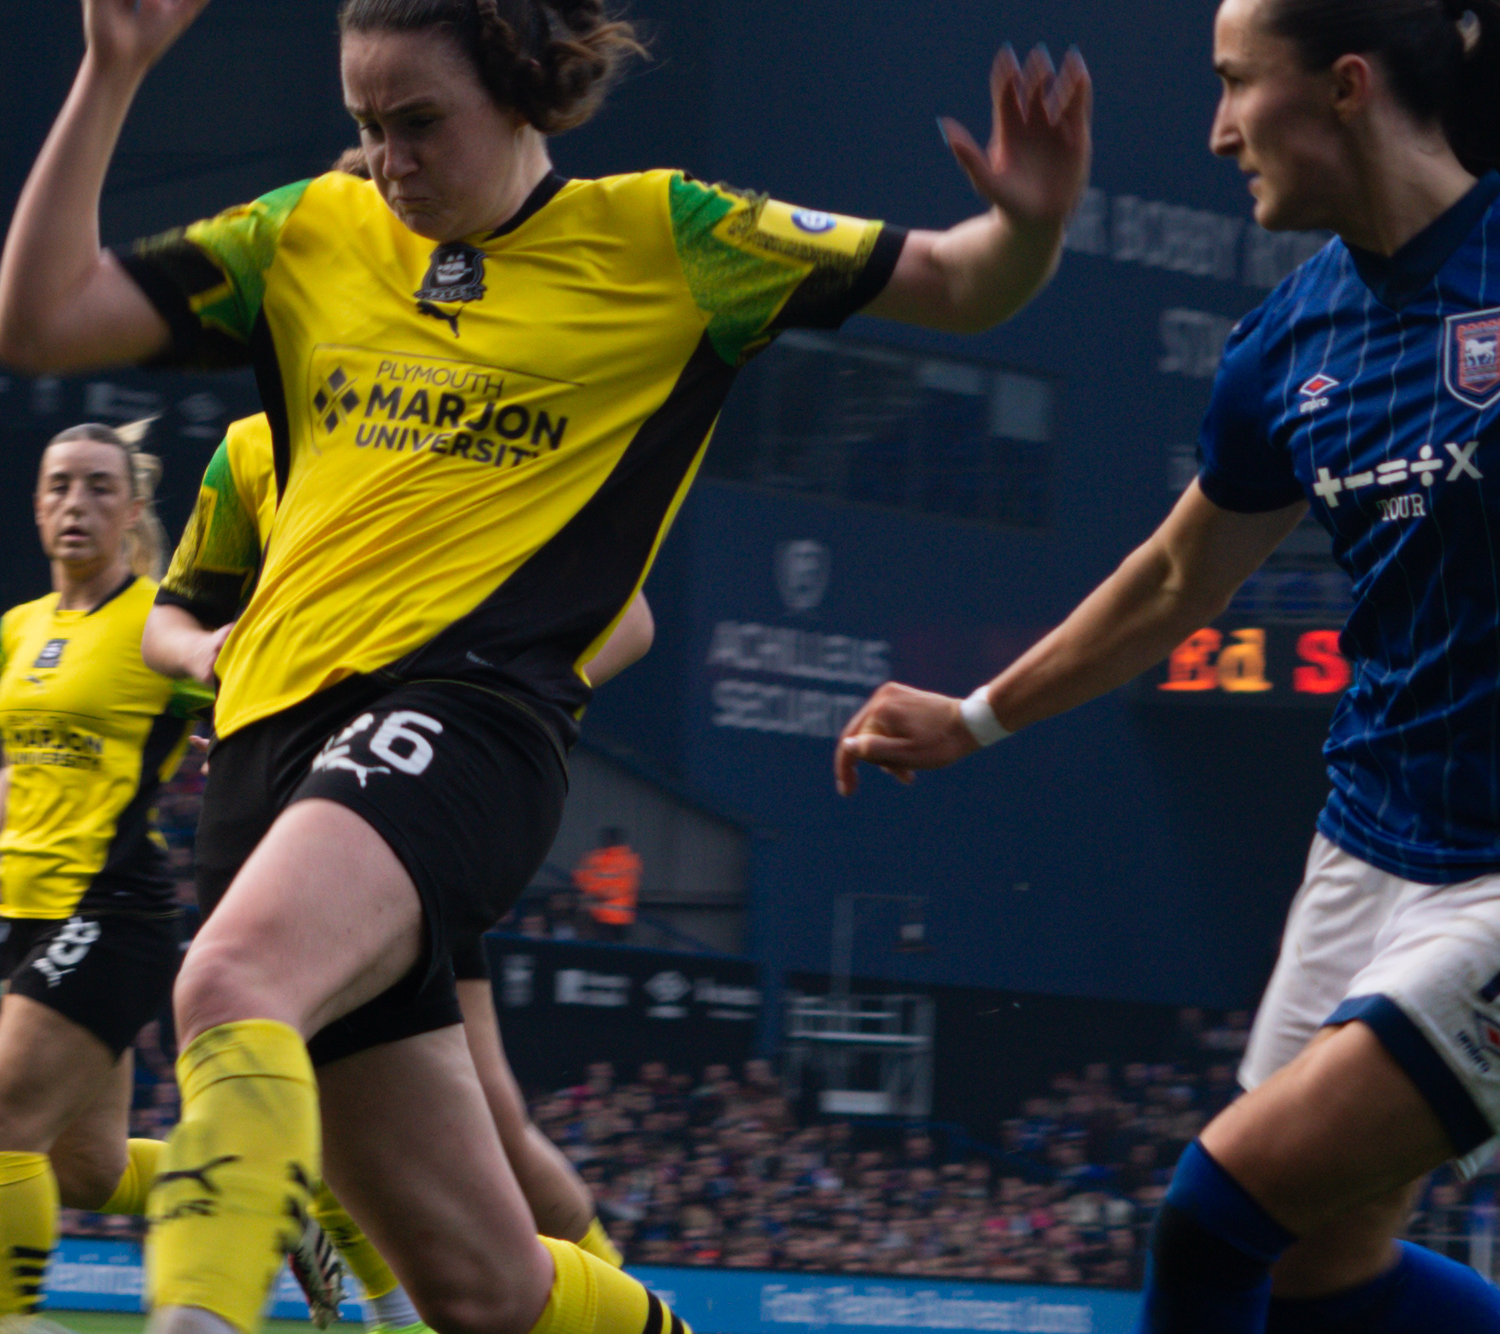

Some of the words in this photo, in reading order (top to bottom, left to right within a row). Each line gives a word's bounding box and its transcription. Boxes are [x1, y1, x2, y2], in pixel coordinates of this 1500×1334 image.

[375, 359, 505, 399] PLYMOUTH
[364, 383, 568, 451] MARJON
[354, 422, 541, 468] UNIVERSIT
[1375, 493, 1427, 522] TOUR
